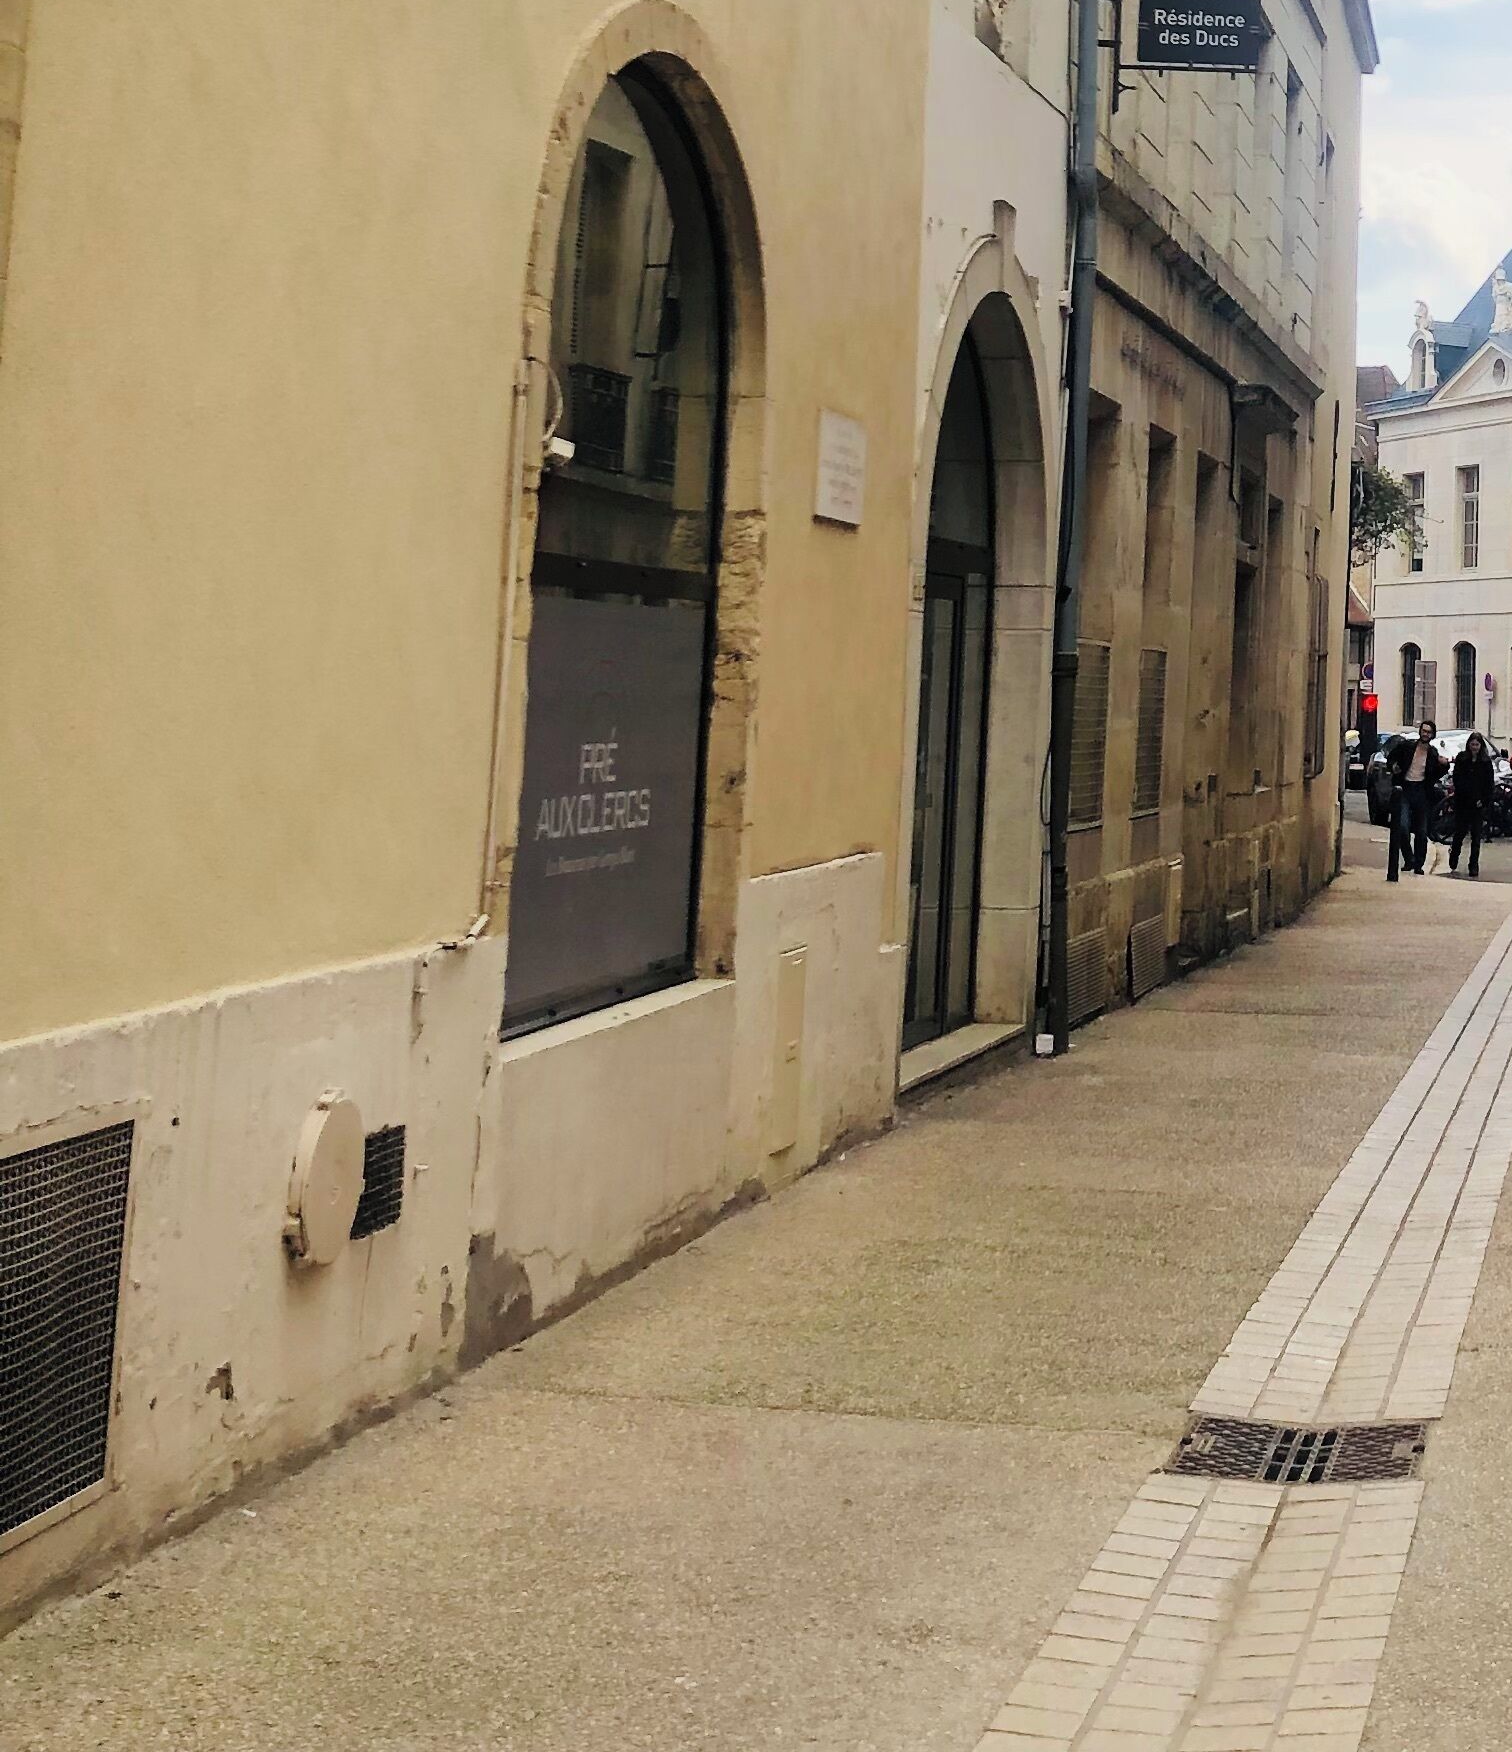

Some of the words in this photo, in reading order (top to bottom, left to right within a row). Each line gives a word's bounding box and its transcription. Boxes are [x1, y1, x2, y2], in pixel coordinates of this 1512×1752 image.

[1153, 8, 1246, 28] Résidence
[1158, 29, 1191, 45] des
[1195, 30, 1240, 47] Ducs
[579, 726, 619, 784] PRÉ
[533, 795, 577, 841] AUX
[577, 788, 651, 835] CLERCS
